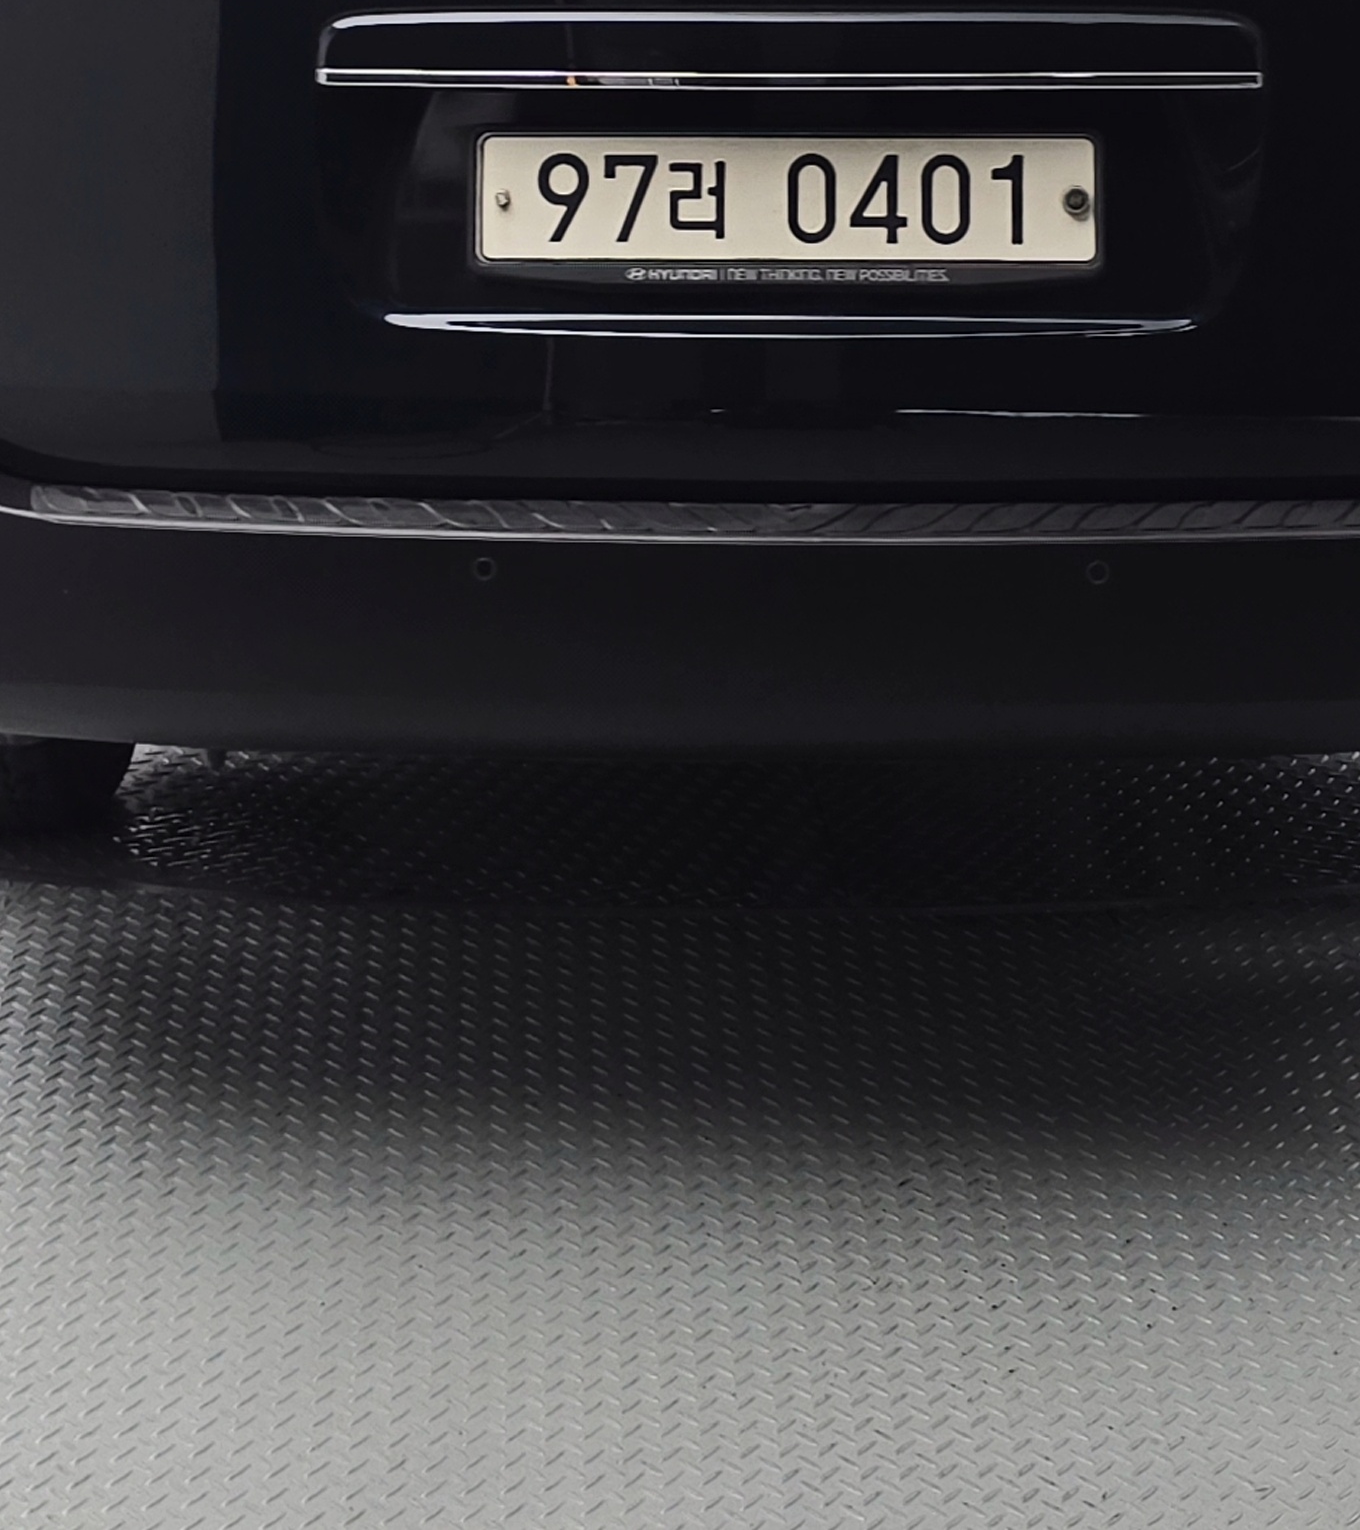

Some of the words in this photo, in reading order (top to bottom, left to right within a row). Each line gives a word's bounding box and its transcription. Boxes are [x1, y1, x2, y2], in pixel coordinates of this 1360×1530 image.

[536, 152, 726, 243] 97러
[786, 152, 1026, 245] 0401
[647, 268, 718, 281] HYUNDAI
